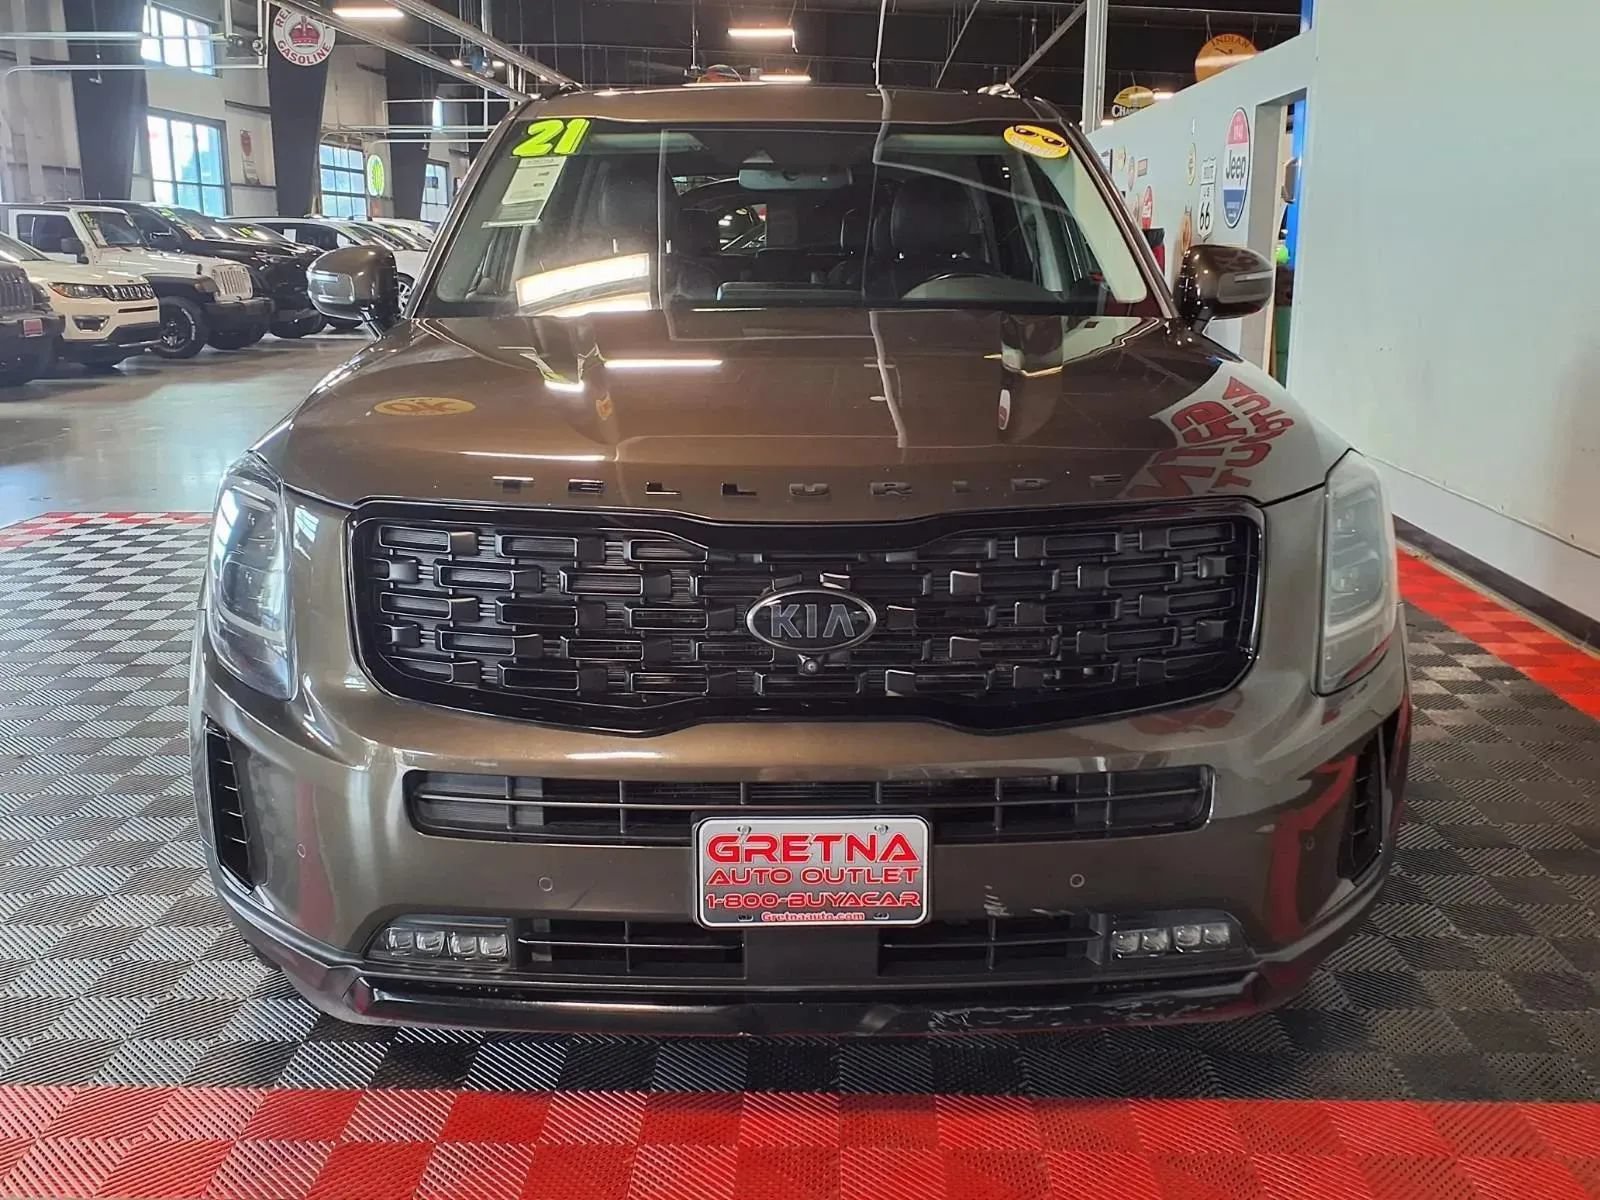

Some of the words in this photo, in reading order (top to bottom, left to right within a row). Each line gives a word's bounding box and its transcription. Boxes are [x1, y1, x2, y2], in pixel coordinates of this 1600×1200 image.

[277, 40, 331, 64] GASOLINE
[1211, 35, 1250, 49] INDIAN
[512, 118, 590, 156] 21
[1225, 149, 1247, 185] Jeep
[1199, 201, 1211, 230] 66
[492, 473, 1124, 497] TELLURIDE
[770, 603, 855, 638] KIA
[706, 832, 920, 864] GRETNA
[706, 867, 793, 886] AUTO
[800, 865, 922, 885] OUTLET
[706, 891, 921, 909] 1-800-BUYACAR
[760, 910, 865, 923] Gretnaauto.com
